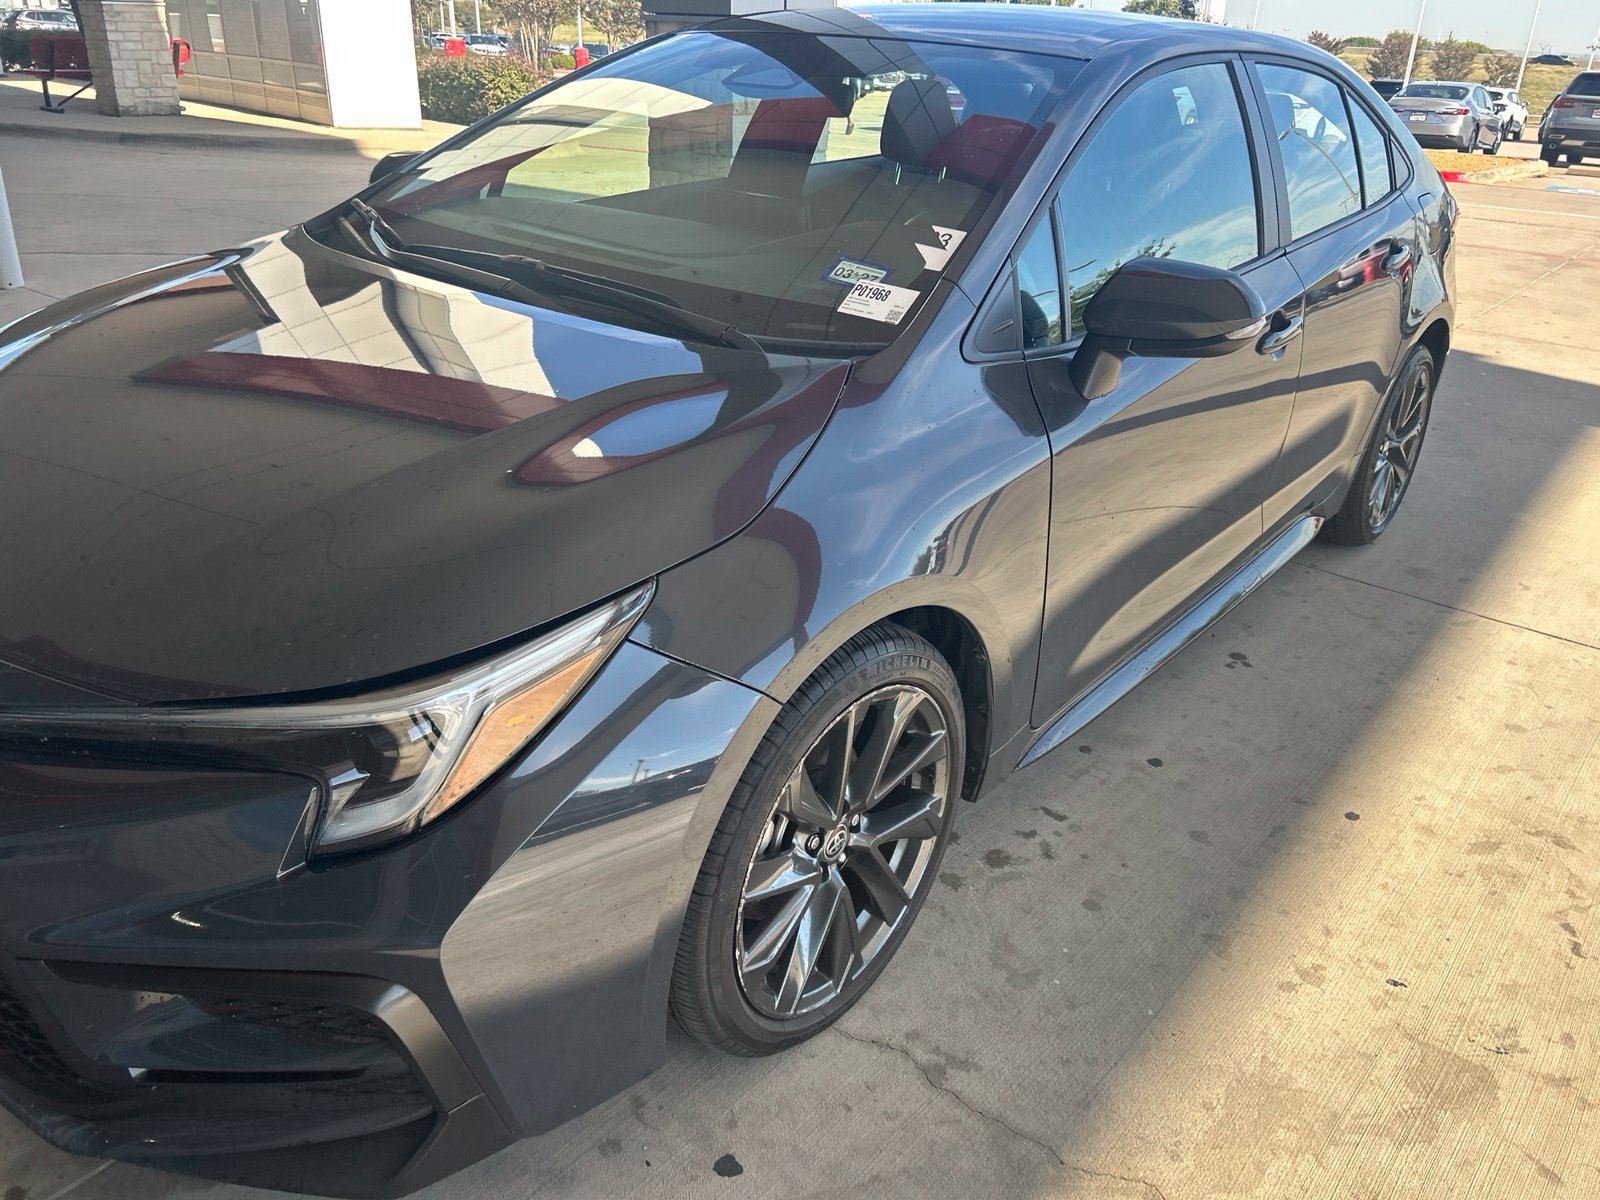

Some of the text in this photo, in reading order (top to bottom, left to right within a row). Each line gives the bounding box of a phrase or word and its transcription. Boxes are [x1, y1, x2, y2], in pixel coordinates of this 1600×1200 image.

[833, 266, 854, 279] 03
[851, 284, 892, 302] P01968
[866, 655, 929, 678] MICHELIN
